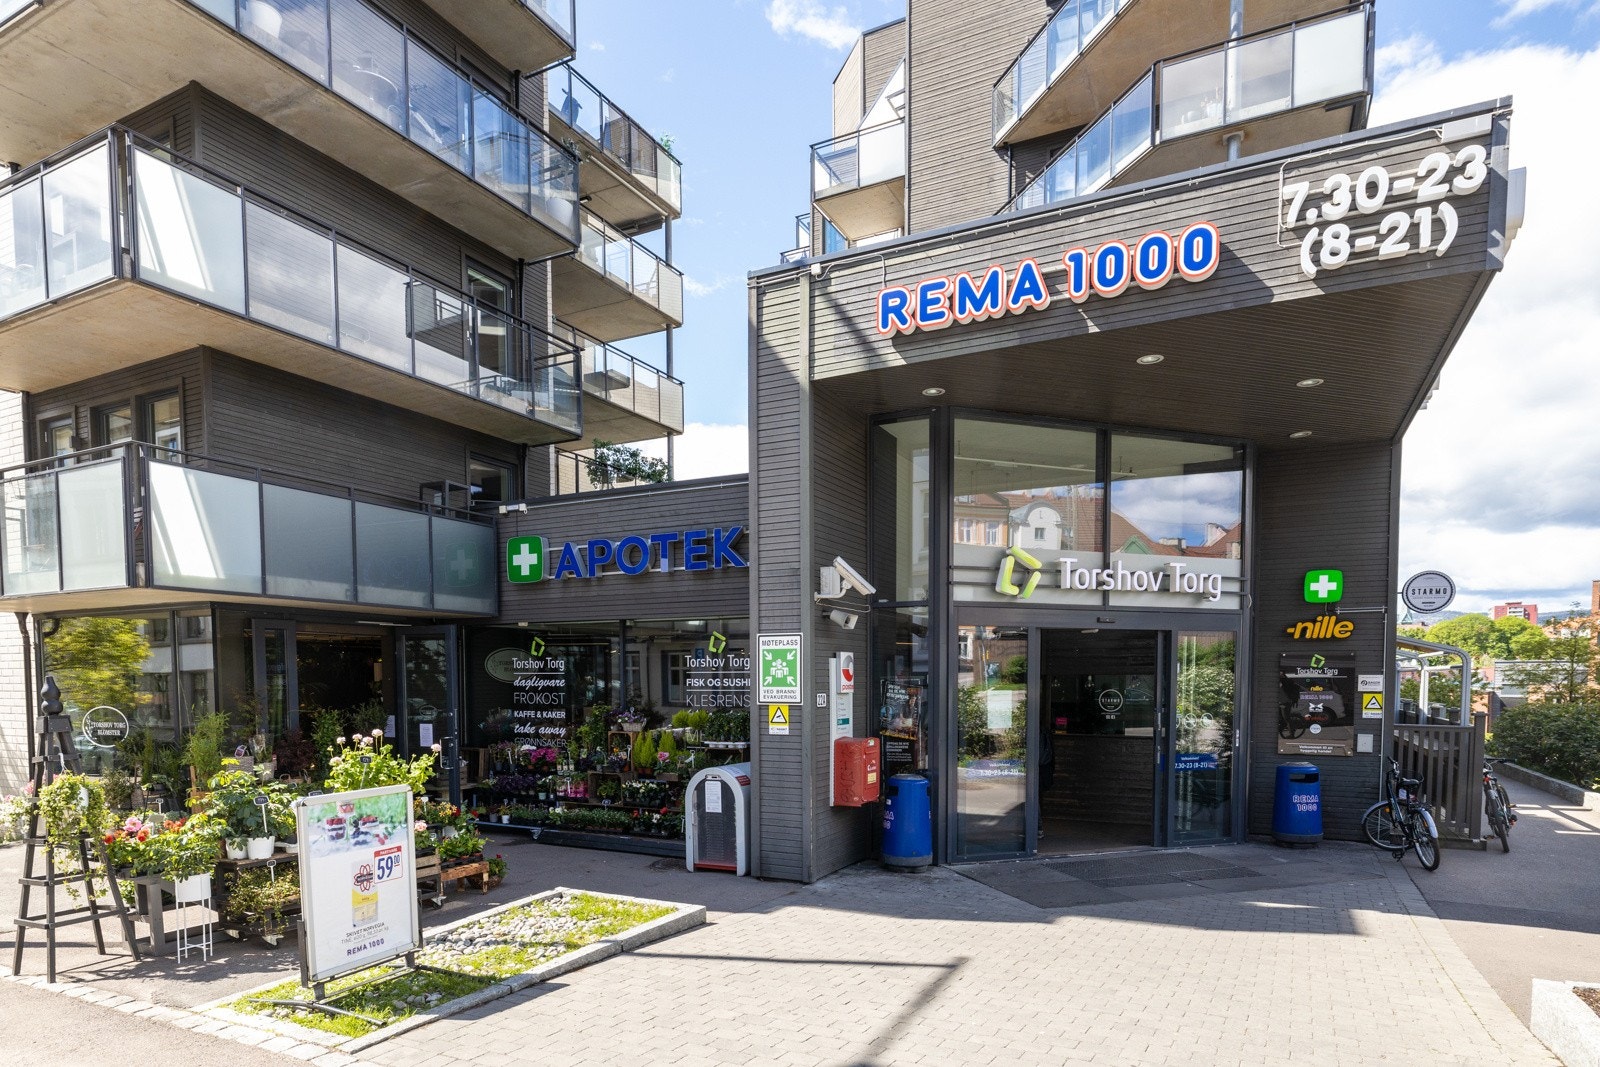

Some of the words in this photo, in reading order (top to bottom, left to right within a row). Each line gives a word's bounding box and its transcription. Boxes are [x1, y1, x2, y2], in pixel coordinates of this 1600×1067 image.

[1283, 145, 1487, 228] 7.30-23
[1301, 202, 1458, 279] (8-21)
[877, 257, 1050, 337] REMA
[1063, 221, 1220, 303] 1000
[554, 526, 748, 580] APOTEK
[1058, 558, 1164, 592] Torshov
[1166, 562, 1222, 602] Torg
[512, 657, 544, 669] Torshov
[546, 657, 565, 671] Torg
[684, 655, 725, 668] Torshov
[727, 654, 750, 670] Torg
[1296, 667, 1322, 675] Torshov
[1324, 667, 1338, 676] Torg
[513, 676, 565, 690] dagligvare
[686, 678, 705, 687] FISK
[706, 678, 720, 687] OG
[723, 678, 750, 687] SUSHI
[513, 692, 565, 705] FROKOST
[686, 694, 750, 707] KLESRENS
[514, 710, 535, 718] KAFFE
[542, 711, 566, 719] KAKER
[514, 722, 535, 734] take
[539, 725, 566, 738] away
[1292, 794, 1319, 803] REMA
[347, 944, 368, 956] REMA
[369, 938, 385, 948] 1000
